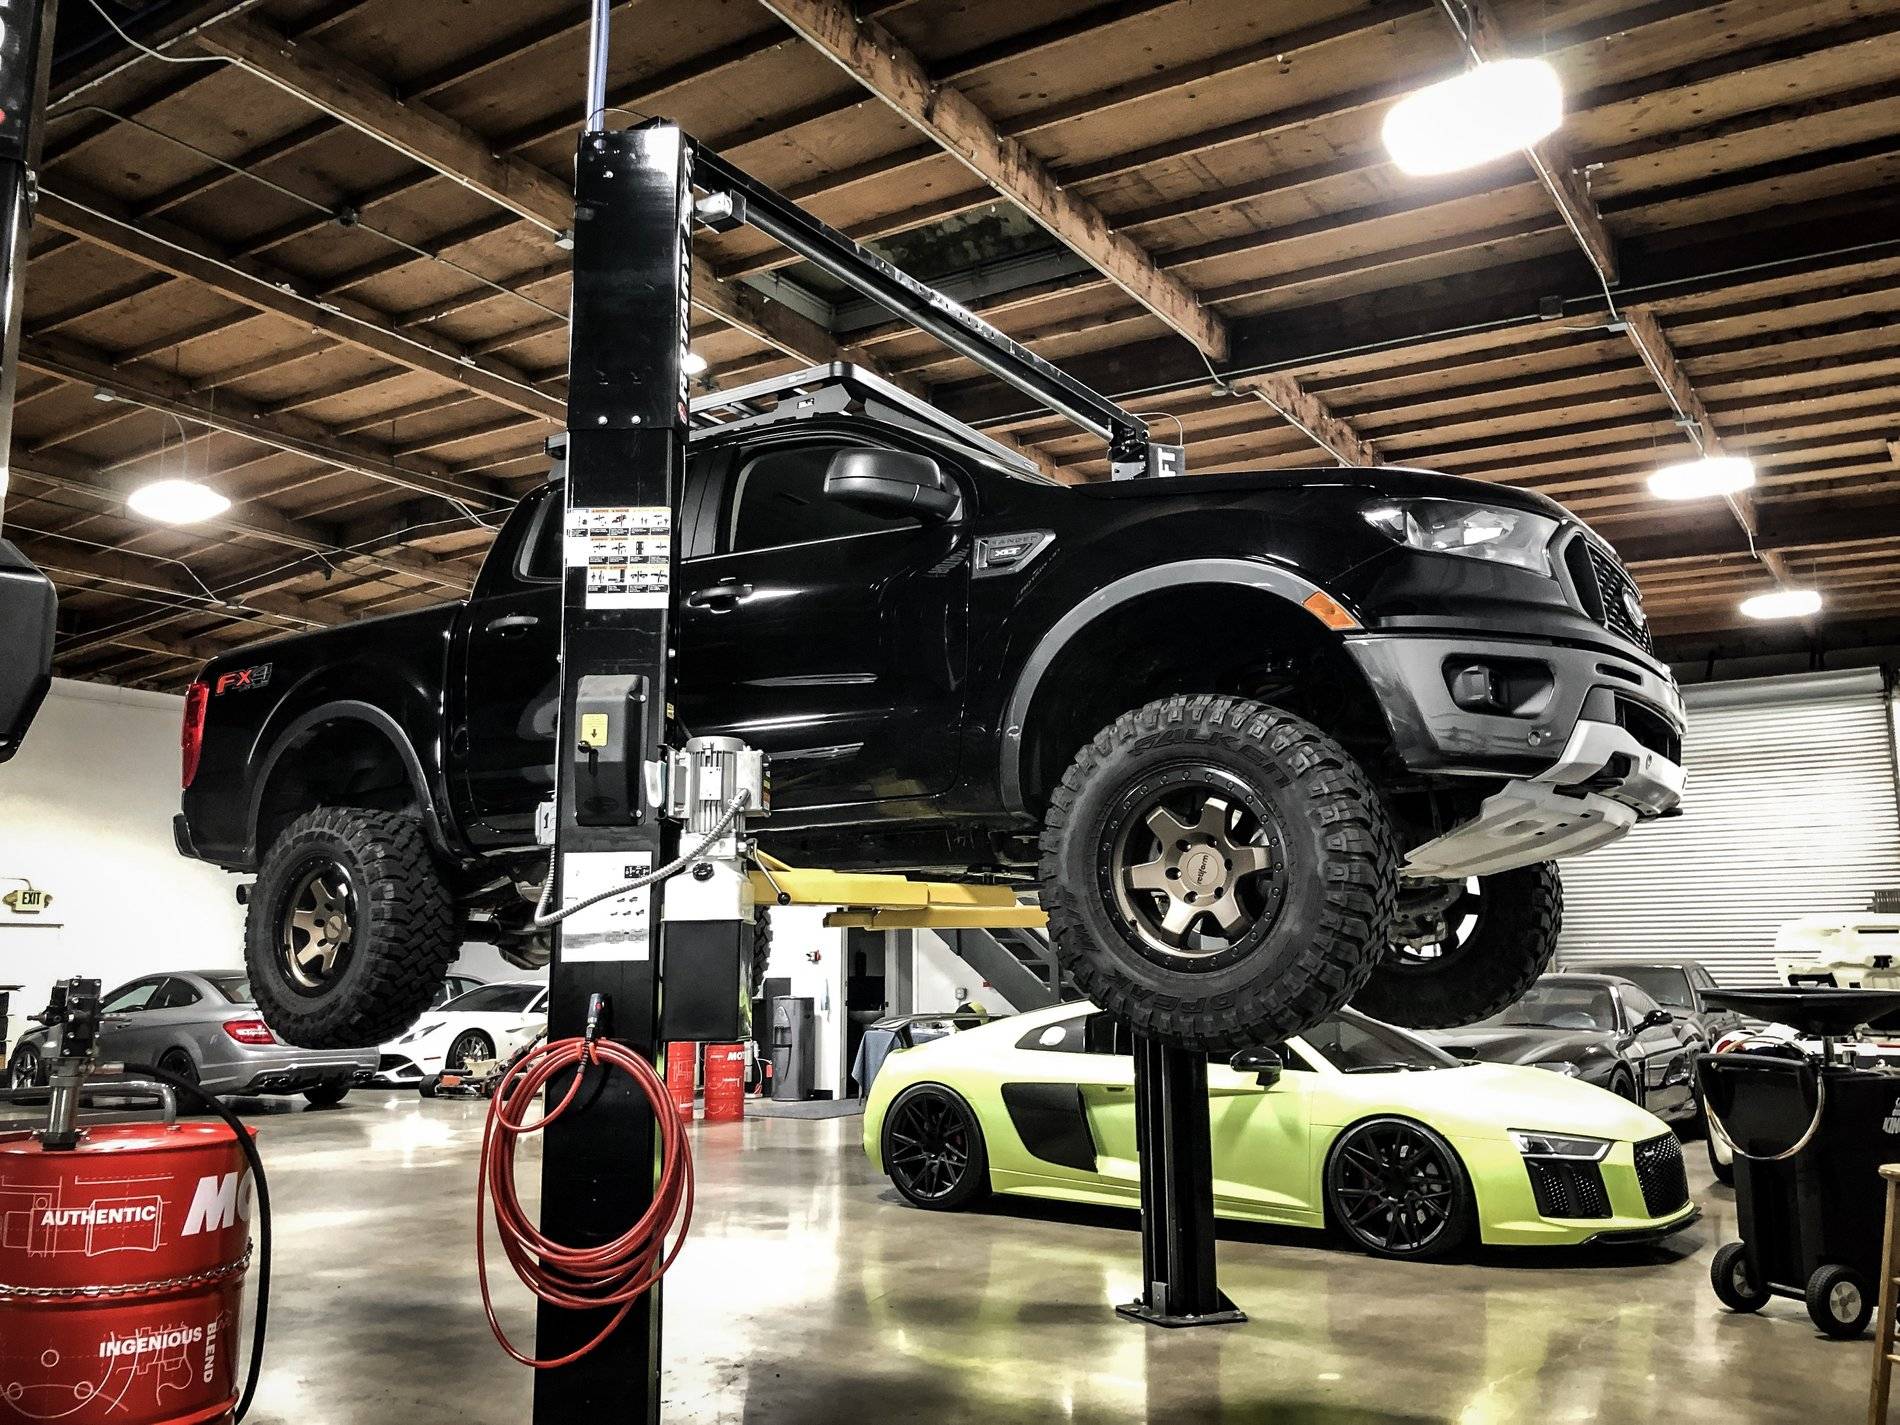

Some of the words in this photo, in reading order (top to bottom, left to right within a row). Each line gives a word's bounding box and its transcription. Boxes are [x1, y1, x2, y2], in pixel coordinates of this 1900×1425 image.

[679, 238, 690, 403] ROTARY
[215, 663, 272, 696] FX4
[22, 892, 41, 905] EXIT
[41, 1206, 156, 1226] AUTHENTIC
[99, 1327, 202, 1358] INGENIOUS
[203, 1322, 217, 1383] BLEND
